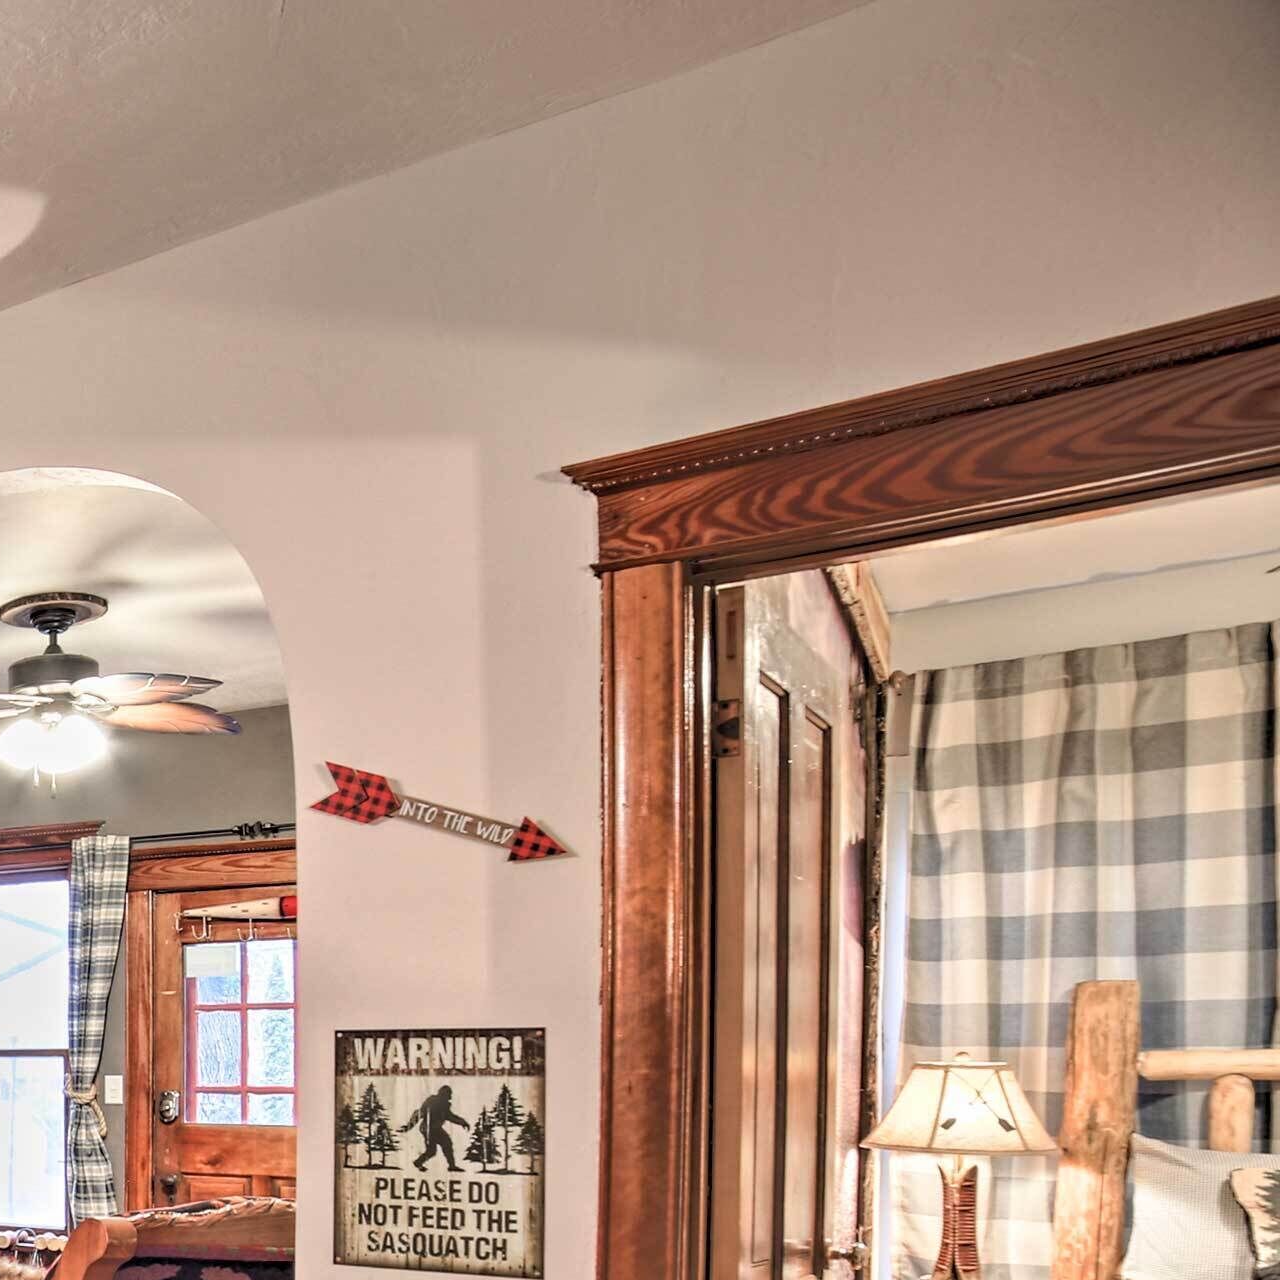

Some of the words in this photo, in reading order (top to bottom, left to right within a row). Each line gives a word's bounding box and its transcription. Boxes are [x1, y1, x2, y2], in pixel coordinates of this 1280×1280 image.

[399, 799, 438, 823] INTO
[443, 810, 468, 833] THE
[477, 821, 513, 843] WILD
[354, 1036, 522, 1070] WARNING!
[375, 1177, 462, 1203] PLEASE
[469, 1181, 500, 1205] DO
[358, 1203, 402, 1227] NOT
[408, 1205, 465, 1230] FEED
[473, 1209, 518, 1233] THE
[367, 1231, 508, 1261] SASQUATCH
